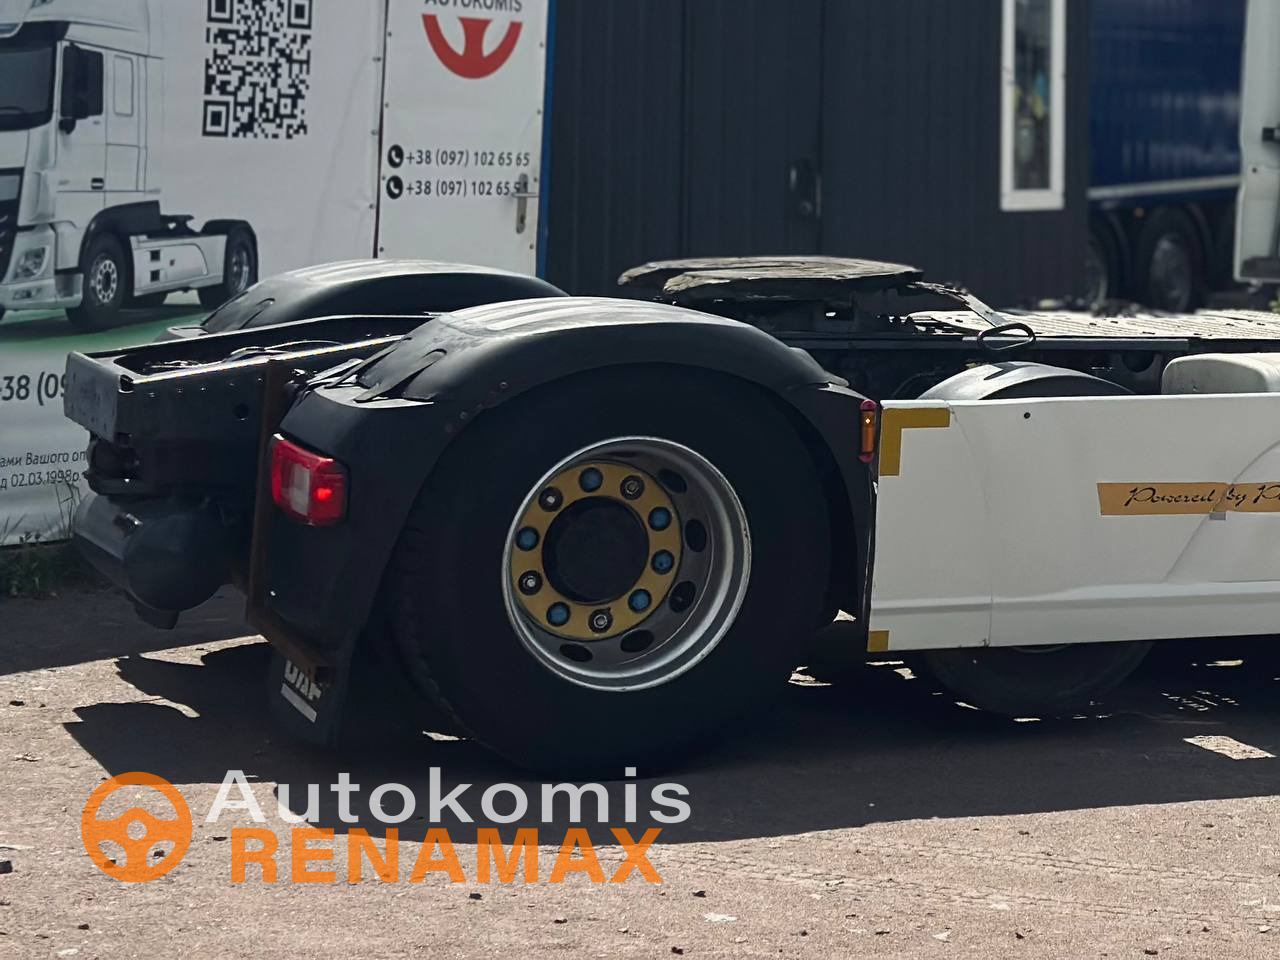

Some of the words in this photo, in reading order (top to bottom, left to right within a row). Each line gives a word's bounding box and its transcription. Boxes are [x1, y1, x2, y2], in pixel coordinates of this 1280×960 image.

[406, 150, 432, 165] +38
[435, 148, 469, 168] (097)
[474, 151, 495, 166] 102
[497, 151, 513, 166] 65
[515, 152, 530, 167] 65
[406, 180, 432, 196] +38
[436, 179, 467, 197] (097)
[471, 181, 493, 196] 102
[496, 181, 511, 196] 65
[0, 374, 31, 401] 38
[25, 452, 69, 466] Вашого
[1123, 487, 1216, 507] Powered
[1226, 487, 1248, 508] by
